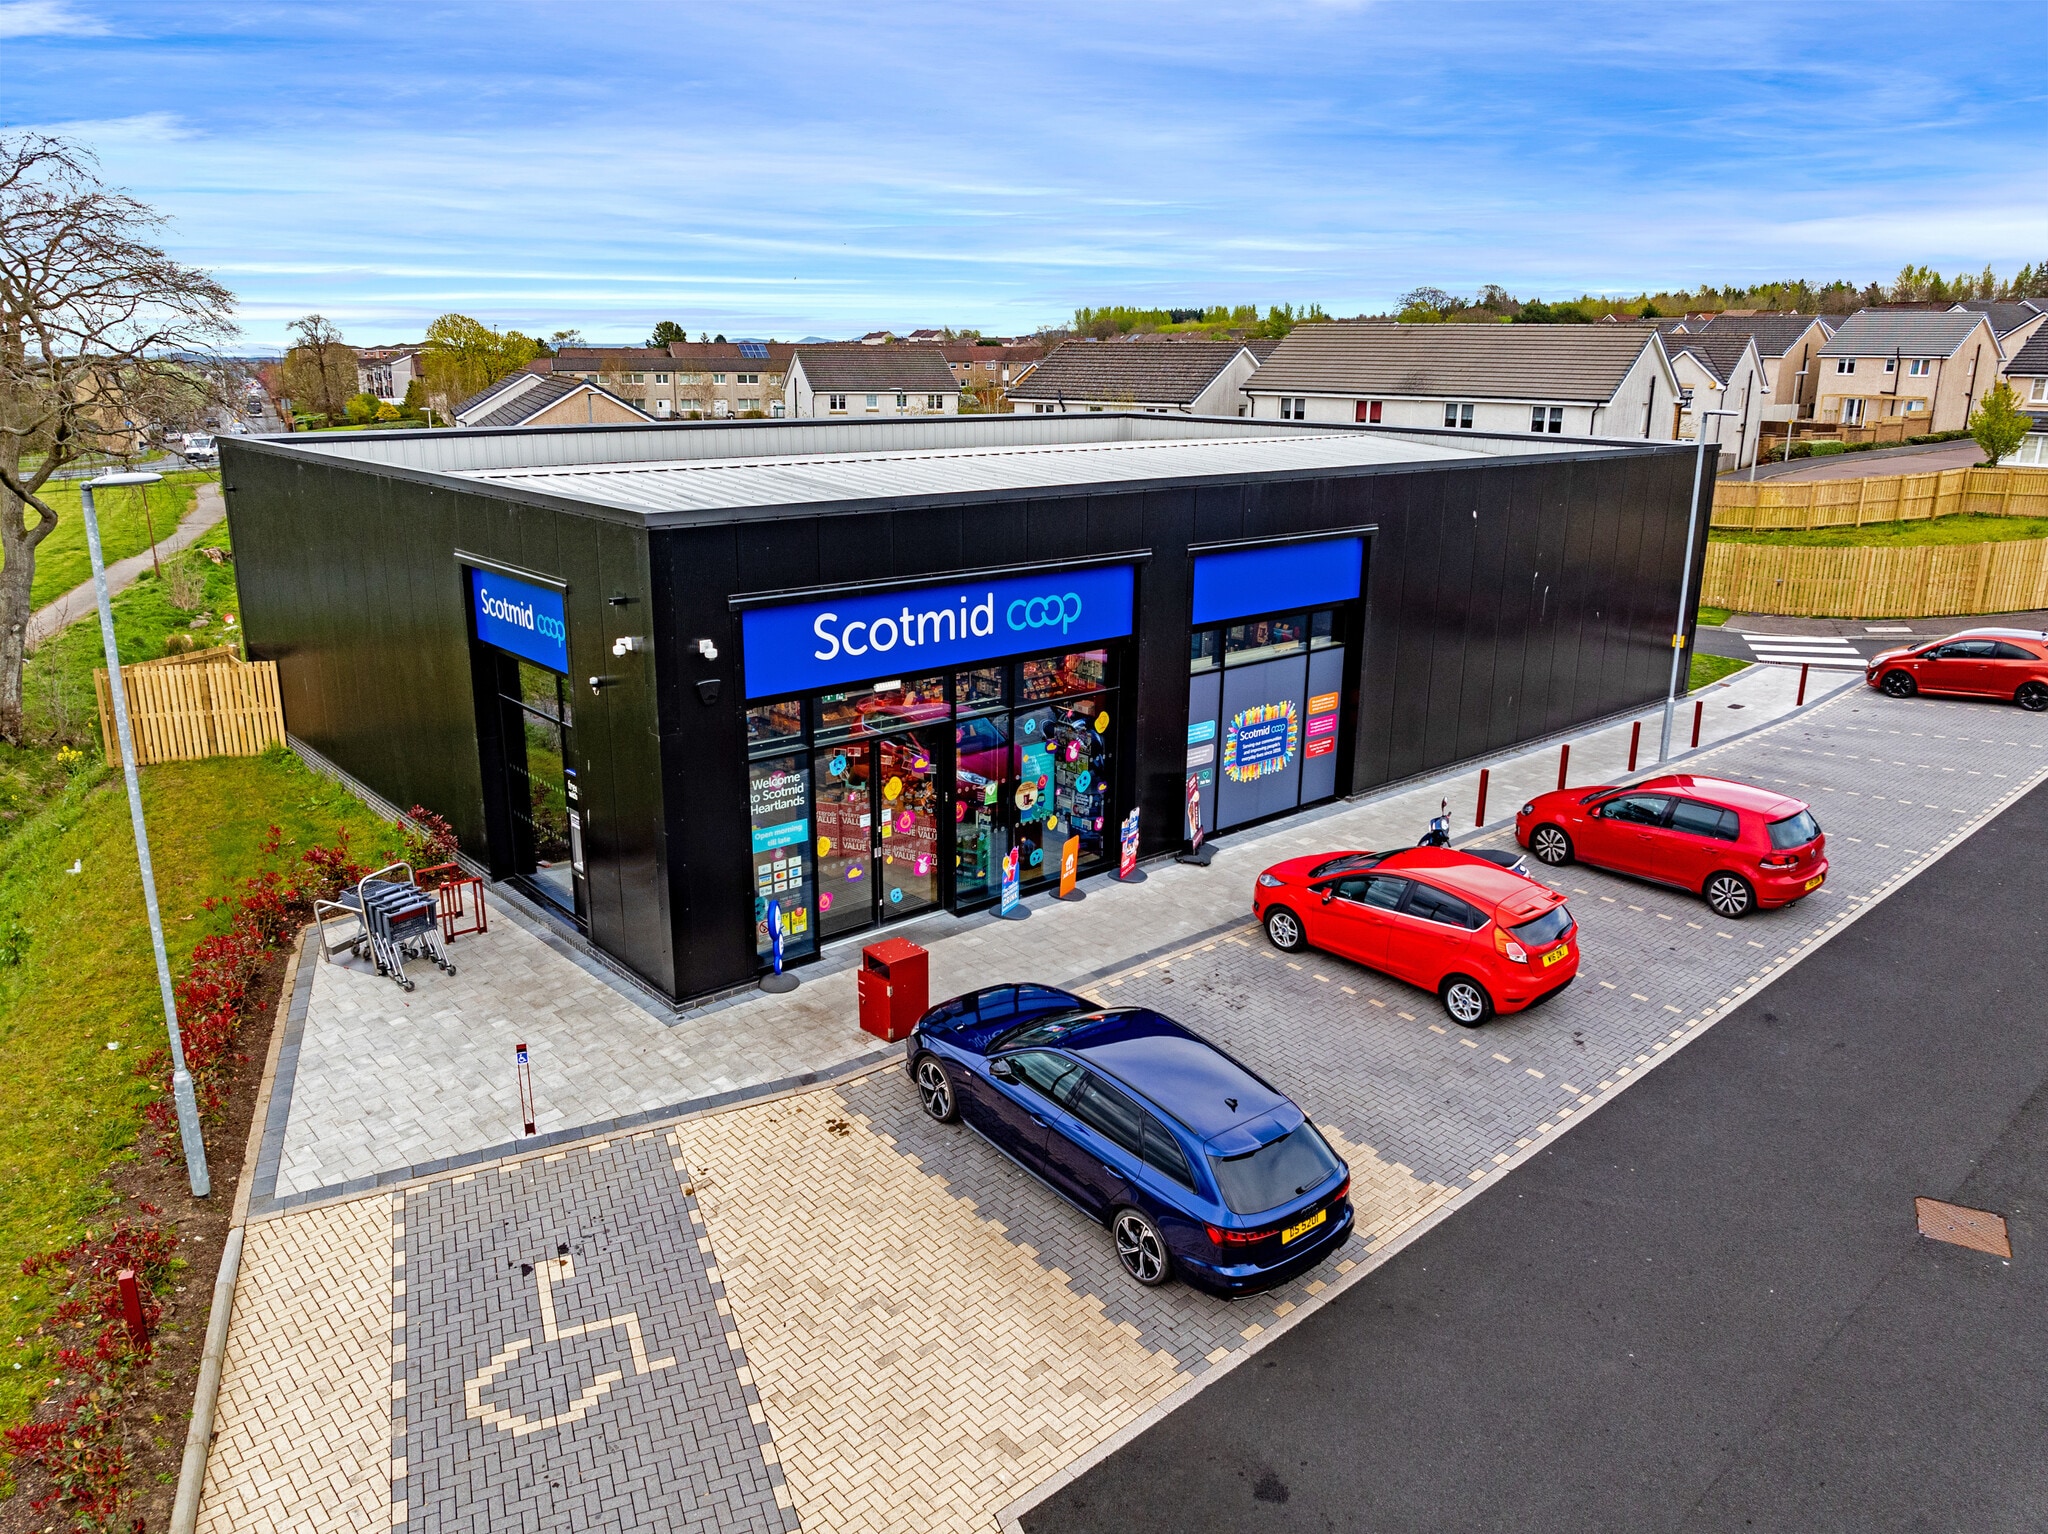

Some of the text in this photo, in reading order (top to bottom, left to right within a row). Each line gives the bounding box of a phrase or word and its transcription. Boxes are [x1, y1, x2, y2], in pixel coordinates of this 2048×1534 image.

[481, 588, 566, 648] Scotmid coop
[813, 592, 1082, 660] Scotmid coop
[1240, 724, 1286, 740] Scotmid coop
[752, 773, 800, 790] Welcome
[750, 782, 804, 803] to Scotmid
[751, 796, 805, 815] Heartlands
[755, 825, 803, 840] Open morning
[778, 836, 791, 844] late
[842, 841, 867, 851] VALUE
[893, 850, 916, 862] VALUE
